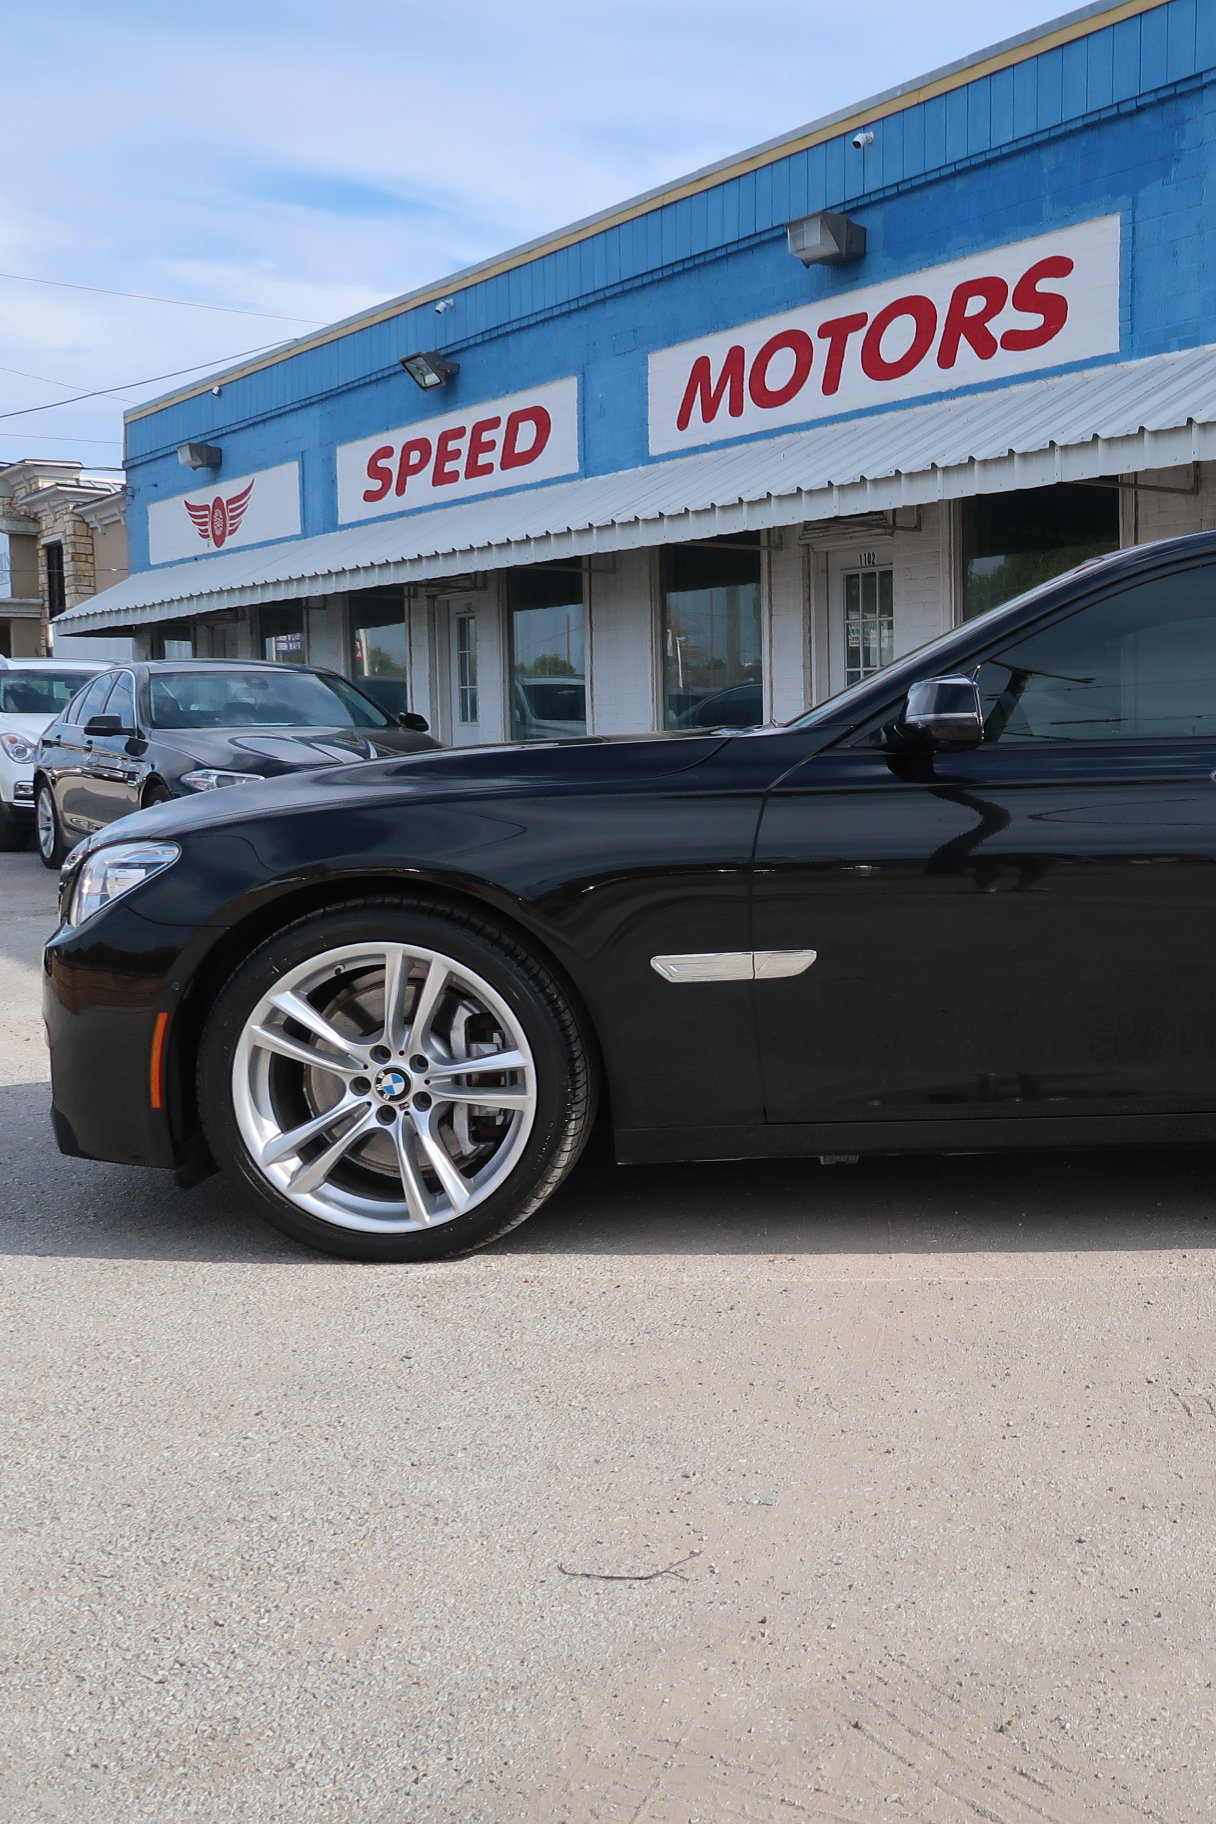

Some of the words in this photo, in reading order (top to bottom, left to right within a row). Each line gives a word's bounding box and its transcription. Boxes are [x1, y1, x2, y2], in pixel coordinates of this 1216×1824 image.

[676, 255, 1074, 431] MOTORS
[363, 405, 551, 502] SPEED
[859, 552, 876, 566] 1102
